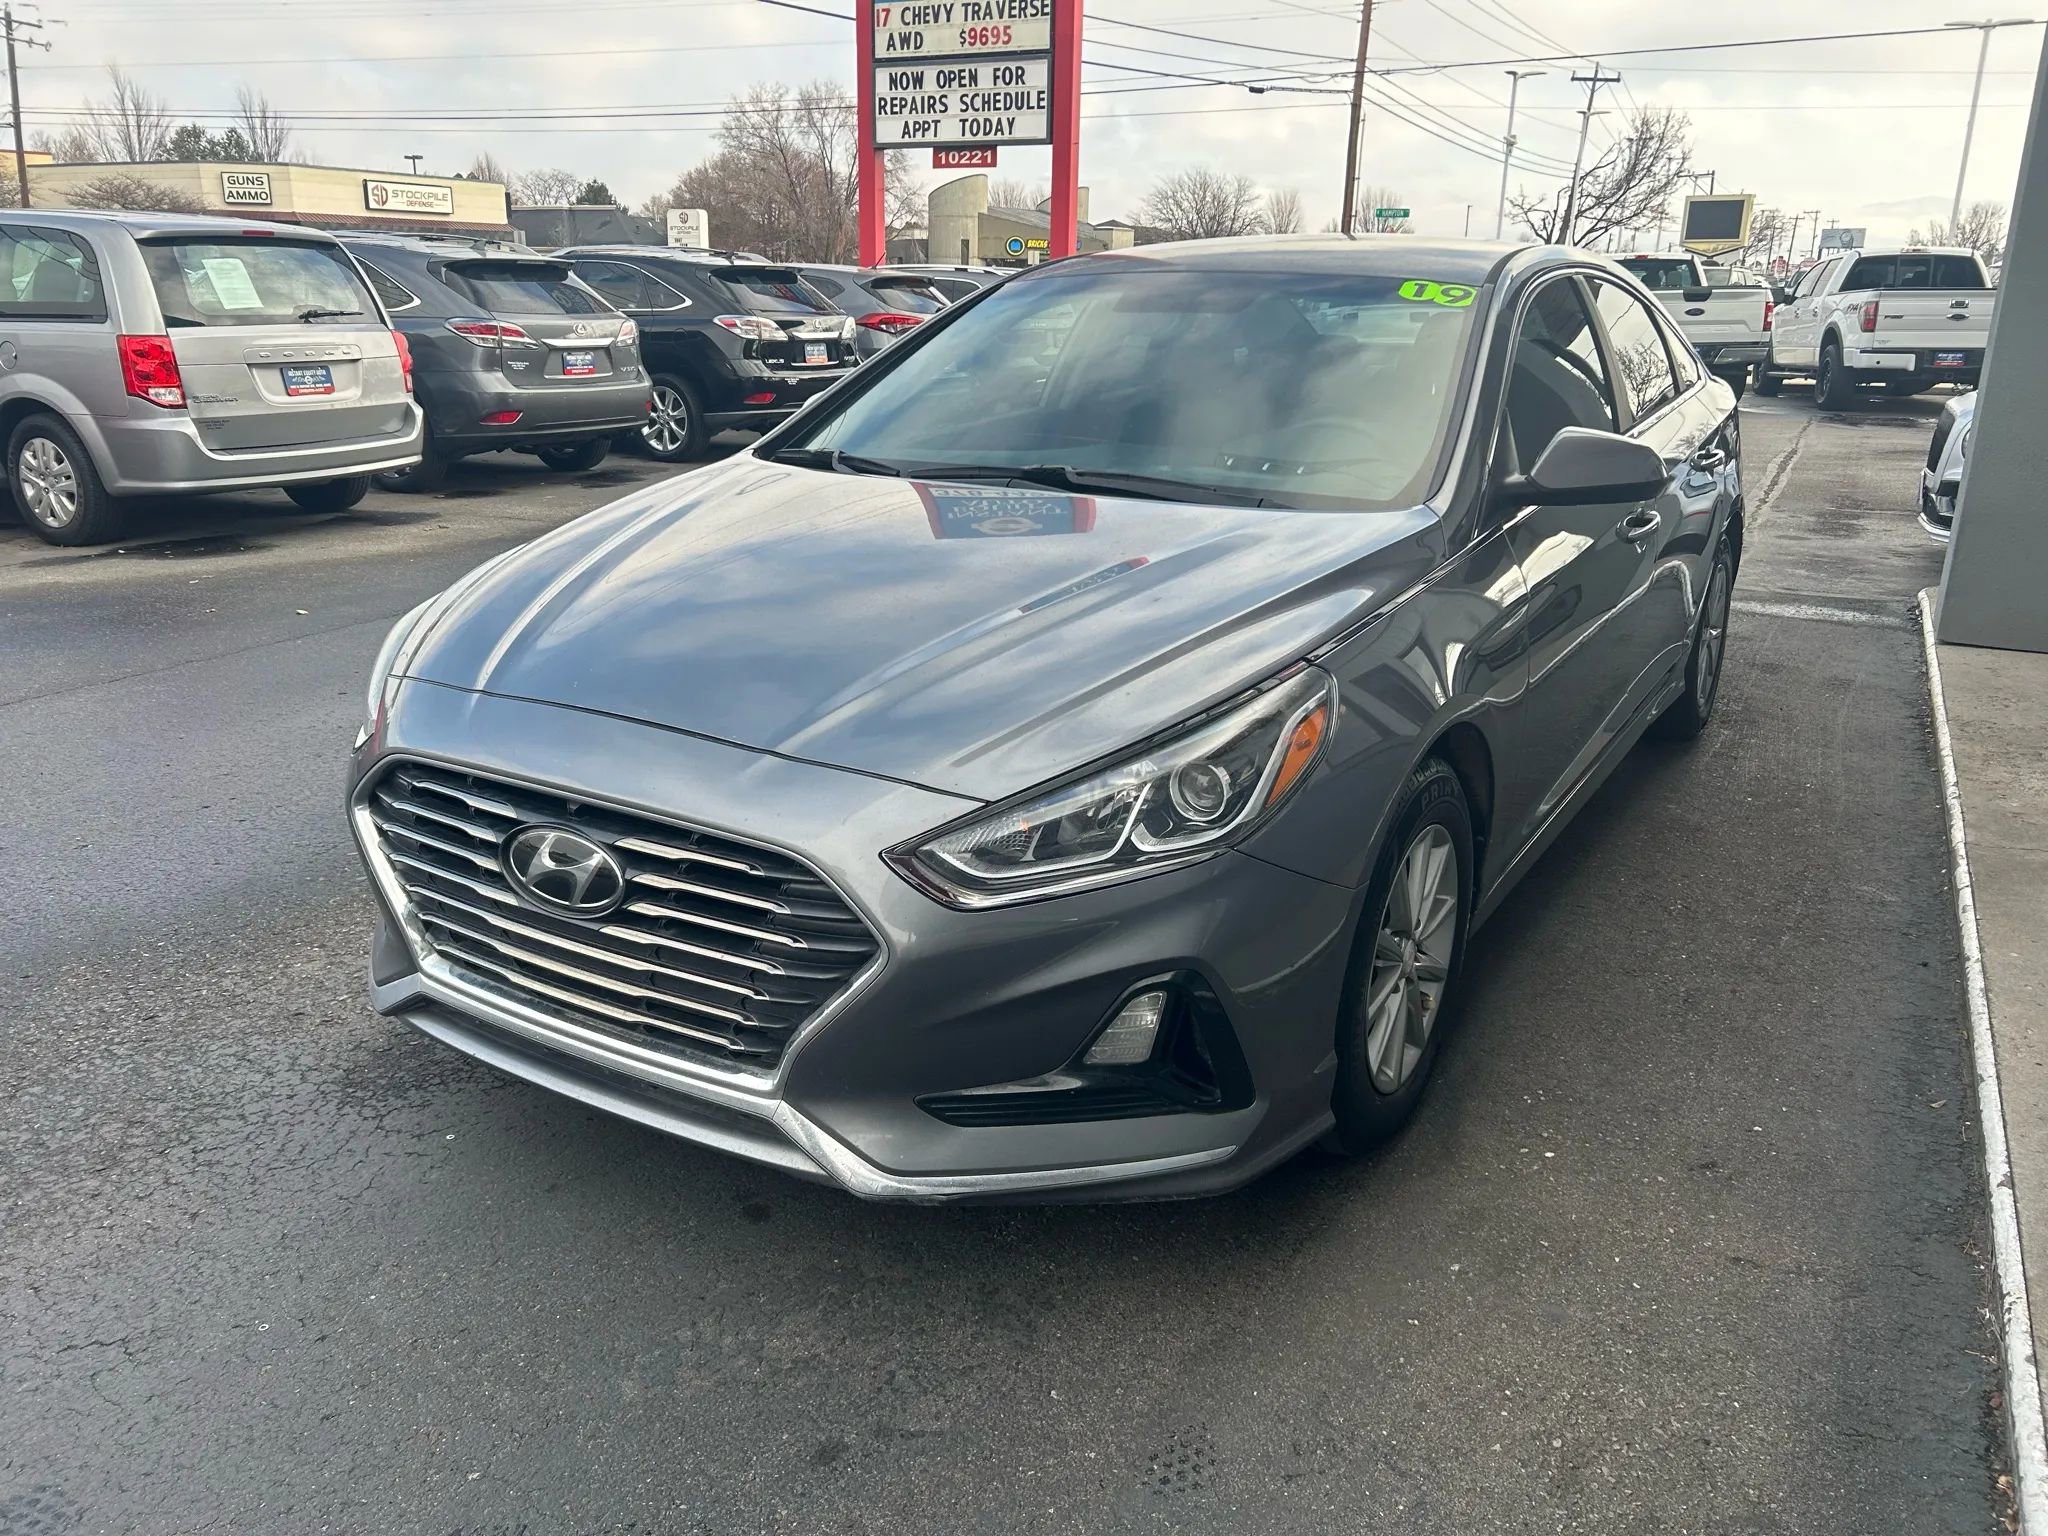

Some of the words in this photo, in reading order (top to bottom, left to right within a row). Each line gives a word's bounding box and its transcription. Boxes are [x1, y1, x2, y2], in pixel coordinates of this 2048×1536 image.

[875, 8, 891, 28] 17
[901, 2, 954, 26] CHEVY
[961, 0, 1050, 22] TRAVERSE
[886, 31, 924, 51] AWD
[959, 25, 1012, 47] $9695
[888, 70, 924, 91] NOW
[936, 68, 978, 88] OPEN
[993, 66, 1026, 86] FOR
[878, 94, 948, 115] REPAIRS
[959, 90, 1046, 113] SCHEDULE
[901, 119, 941, 139] APPT
[959, 117, 1016, 137] TODAY
[938, 150, 992, 165] 10221
[227, 175, 264, 186] GUNS
[226, 190, 269, 201] AMMO
[391, 189, 449, 201] STOCKPILE
[406, 200, 435, 208] DEFENSE
[1027, 239, 1048, 249] BRICKS
[1412, 282, 1474, 304] 19
